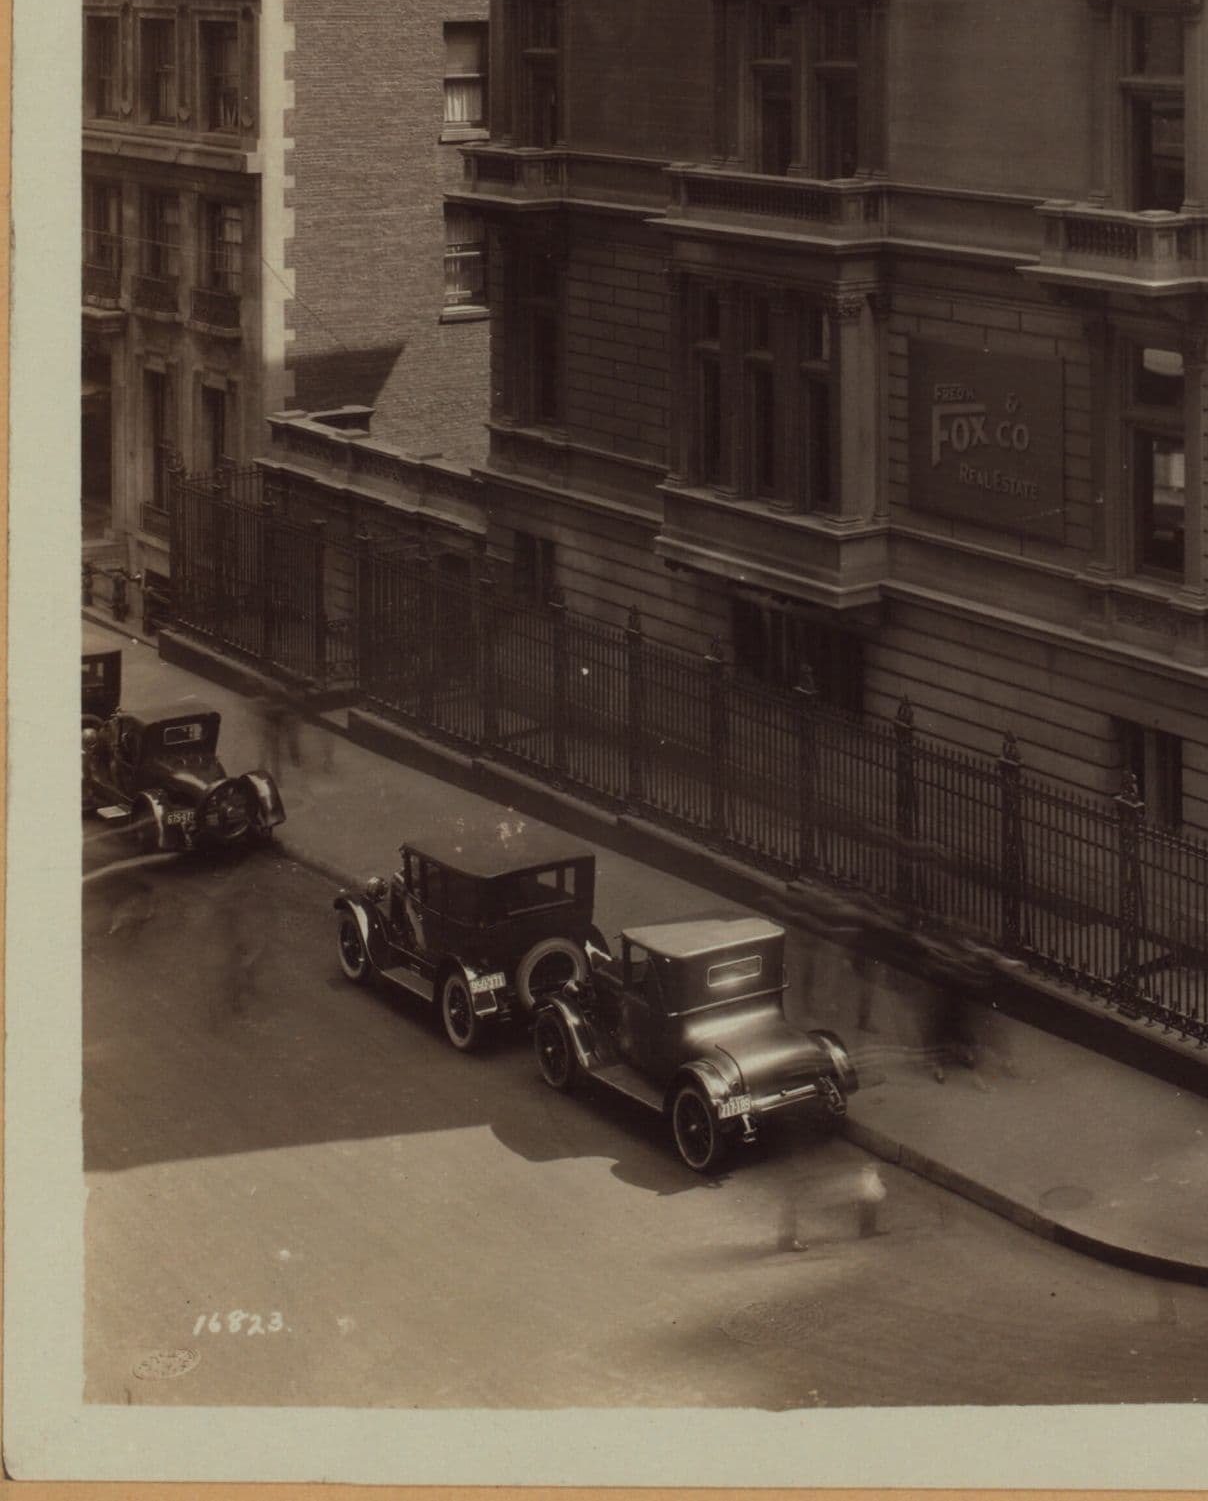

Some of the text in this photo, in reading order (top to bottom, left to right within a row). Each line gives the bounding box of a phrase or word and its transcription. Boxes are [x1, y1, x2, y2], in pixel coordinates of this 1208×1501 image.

[932, 404, 1030, 468] FOX CO
[960, 462, 1041, 501] REAL ESTATE
